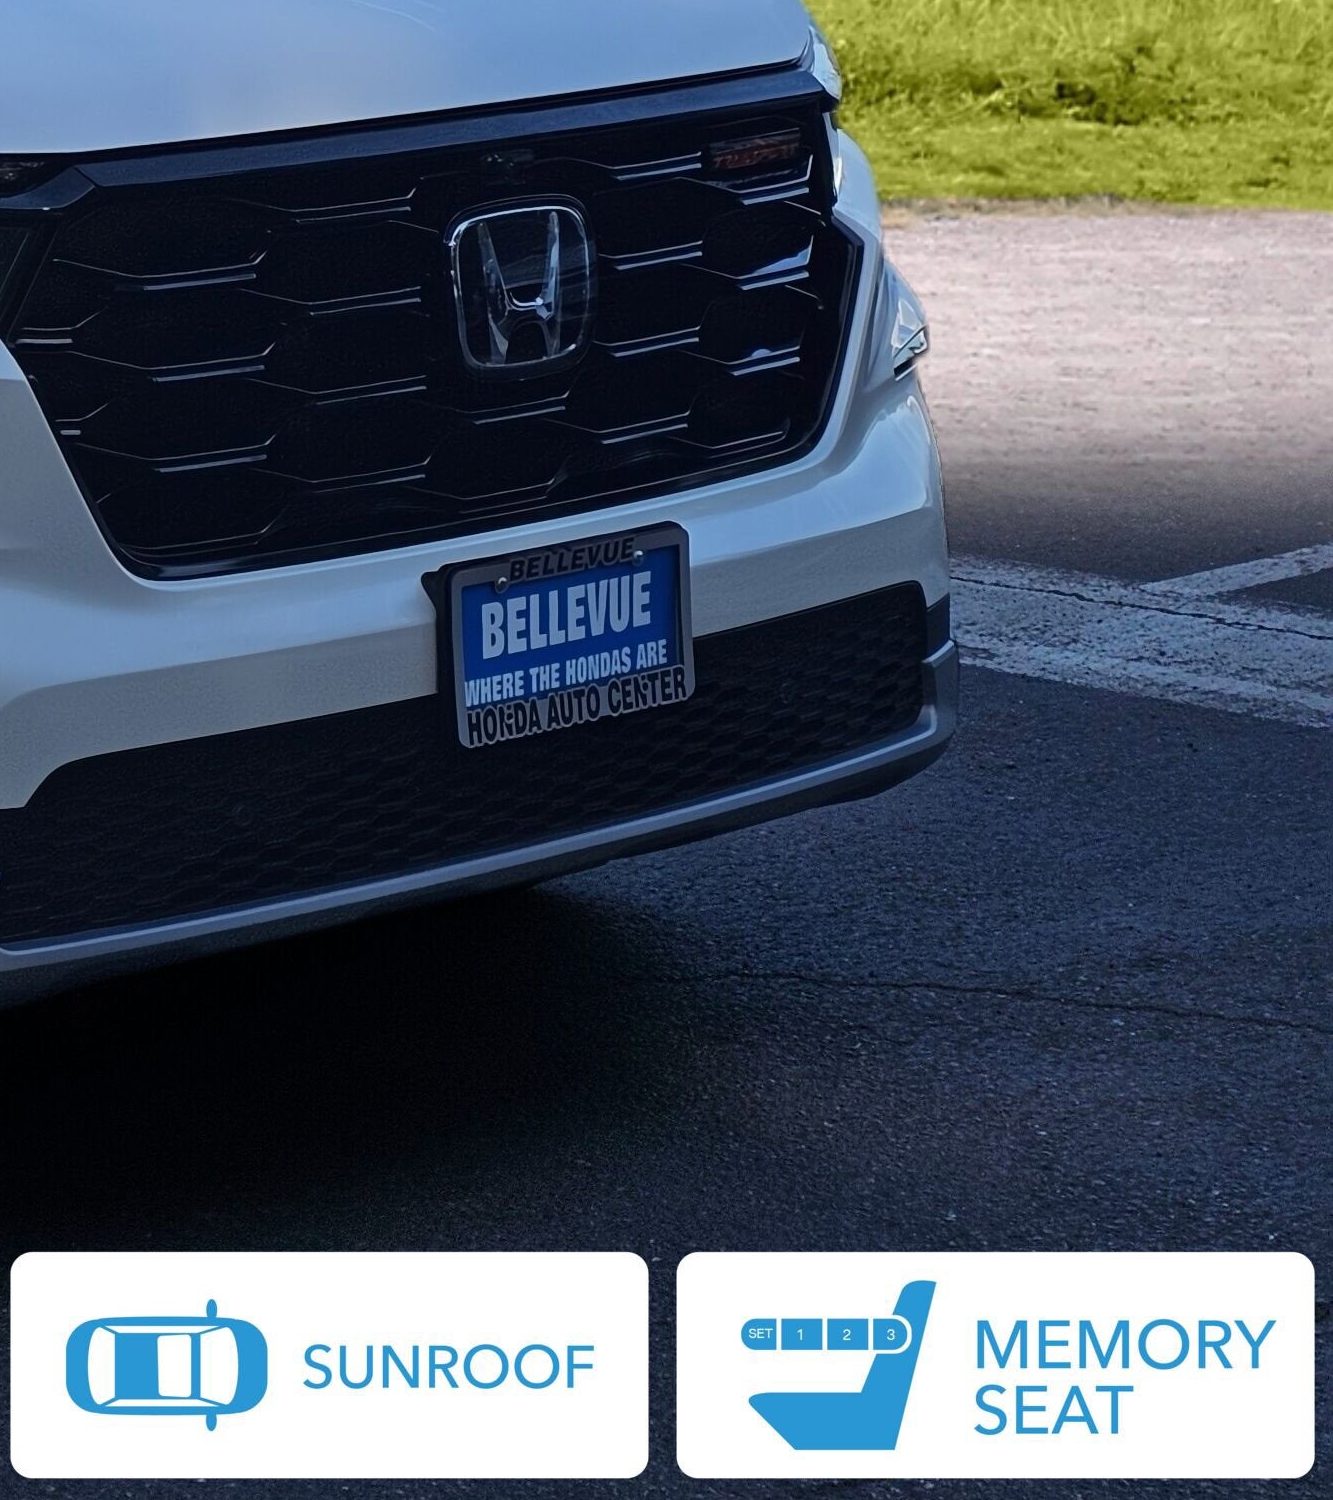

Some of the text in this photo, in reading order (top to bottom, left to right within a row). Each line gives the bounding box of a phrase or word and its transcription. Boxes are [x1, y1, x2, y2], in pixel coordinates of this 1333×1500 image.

[509, 537, 636, 581] BELLEVUE
[481, 570, 652, 660] BELLEVUE
[464, 639, 668, 708] WHERE THE HONDAS ARE
[466, 667, 687, 746] HONDA AUTO CENTER
